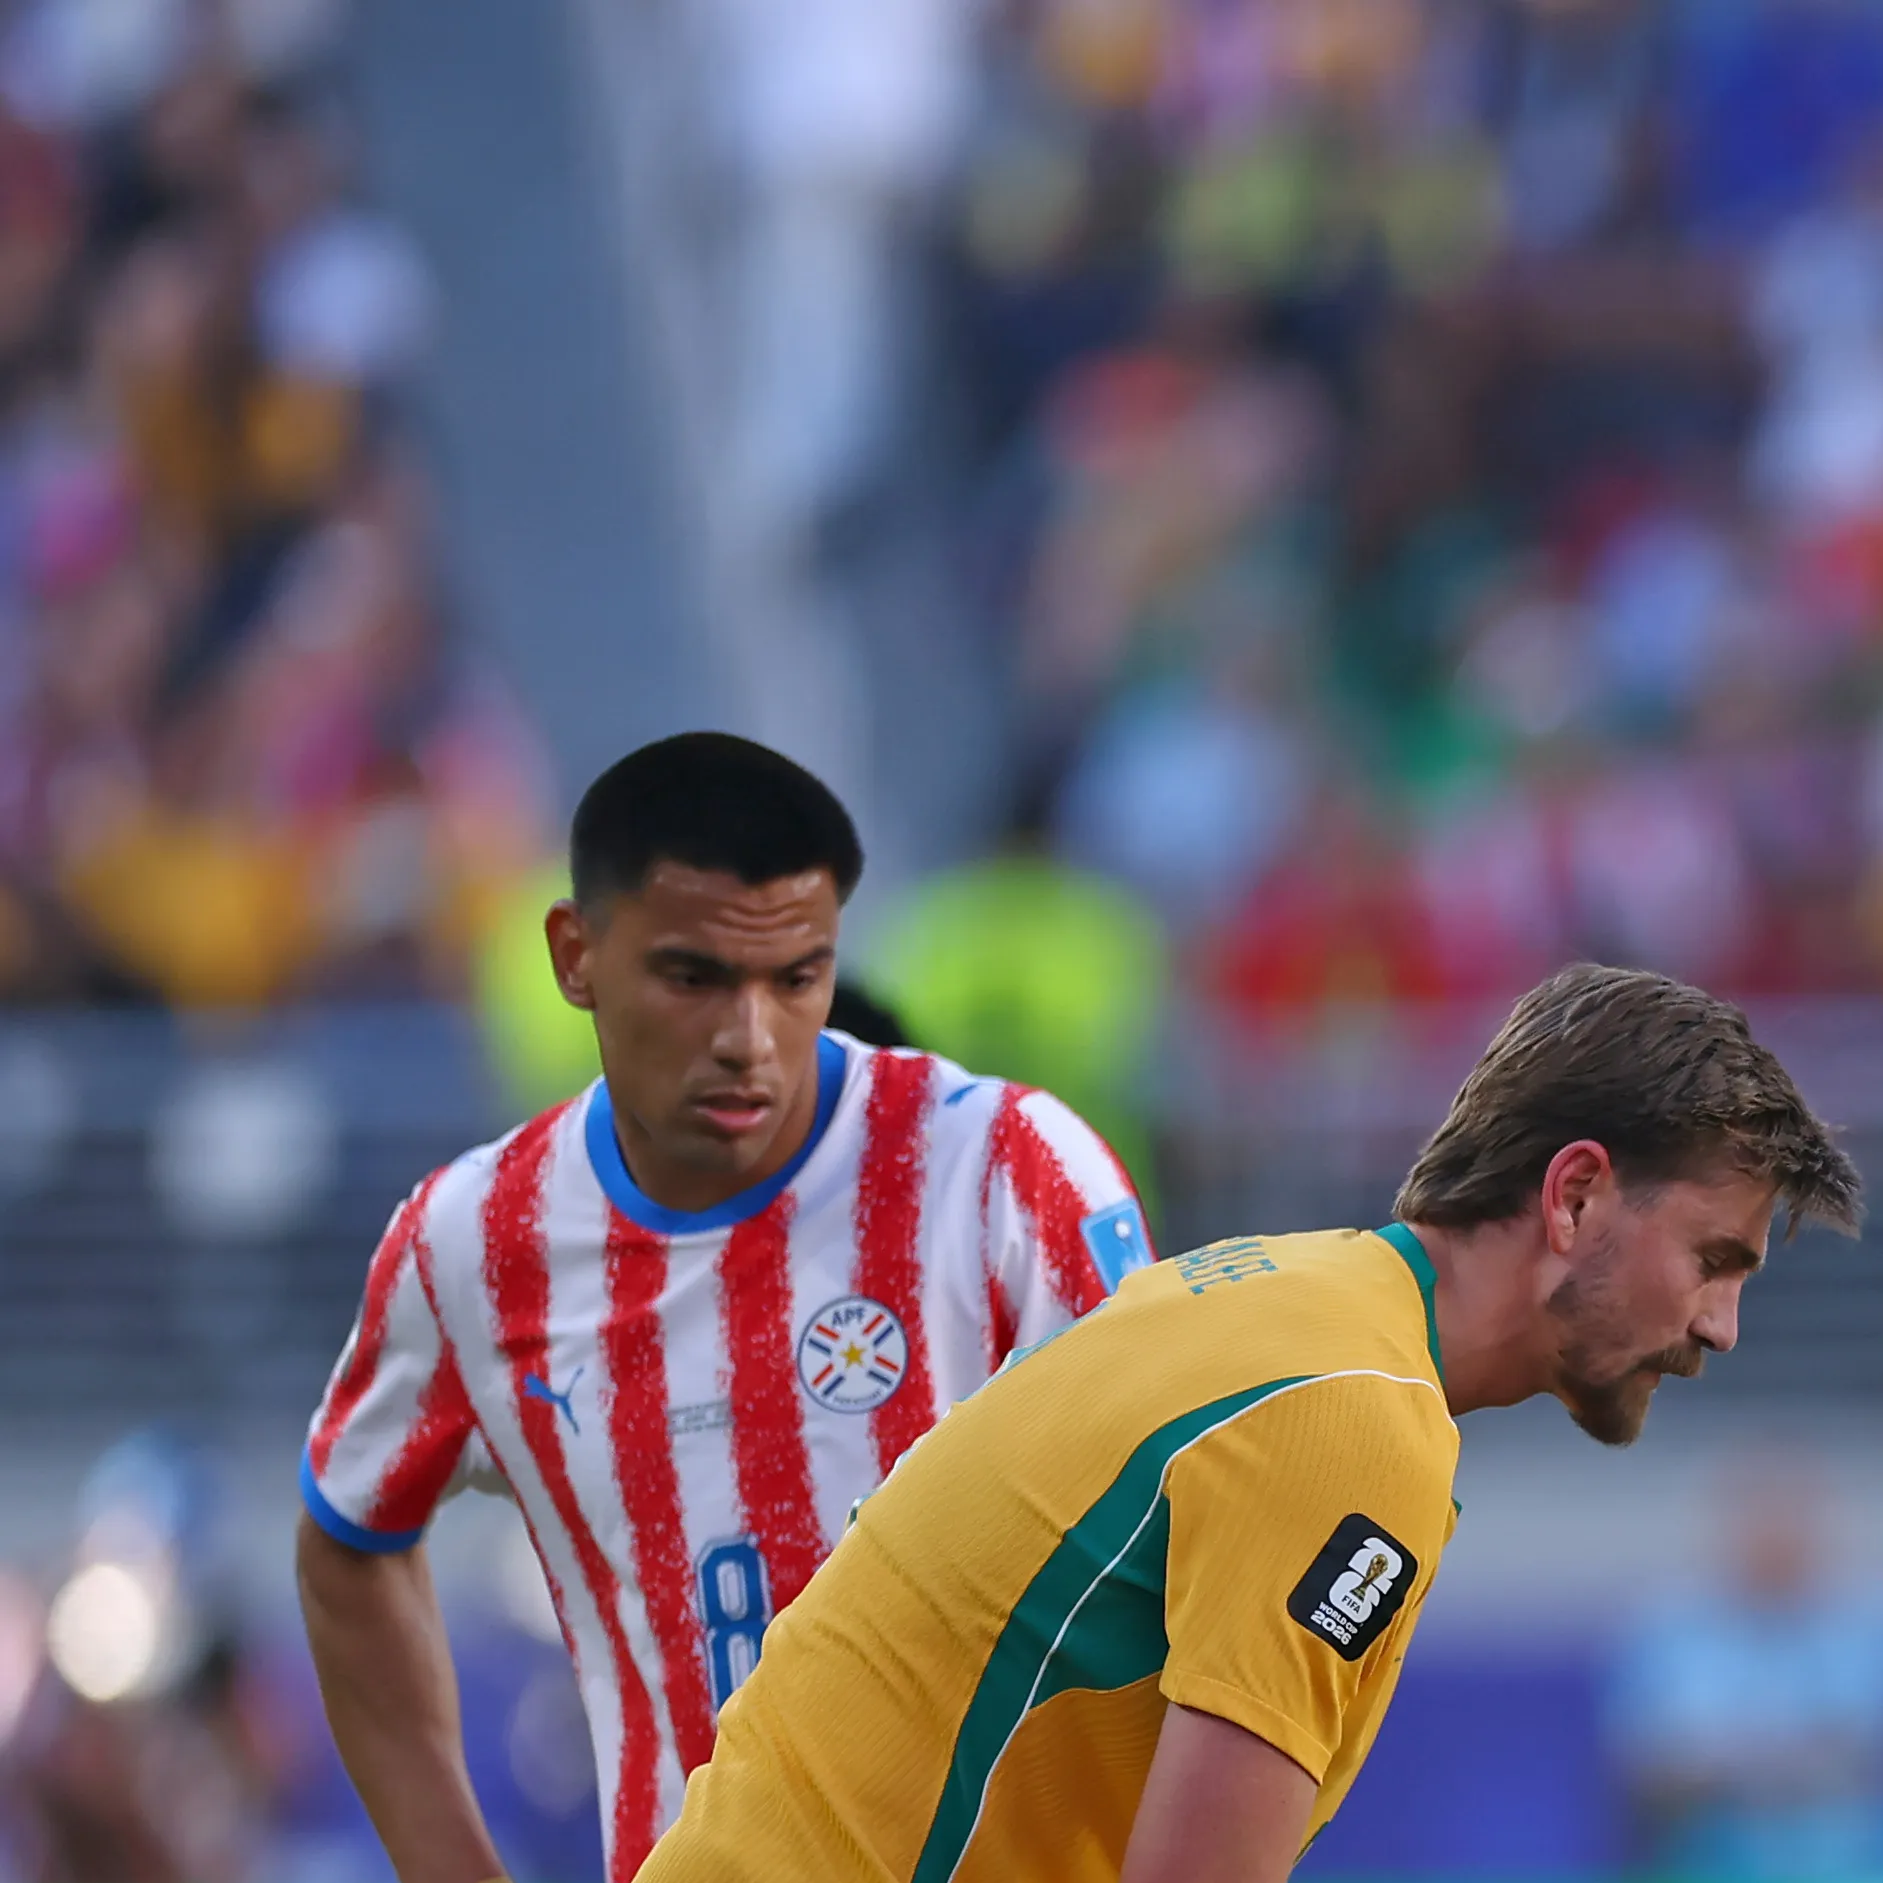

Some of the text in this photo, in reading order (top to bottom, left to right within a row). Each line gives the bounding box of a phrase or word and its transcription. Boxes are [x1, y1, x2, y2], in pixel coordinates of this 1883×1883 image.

[832, 1307, 865, 1326] APF
[1319, 1602, 1358, 1634] WORLD CUP
[1341, 1595, 1361, 1614] FIFA
[694, 1532, 773, 1713] 8
[1310, 1610, 1352, 1645] 2026
